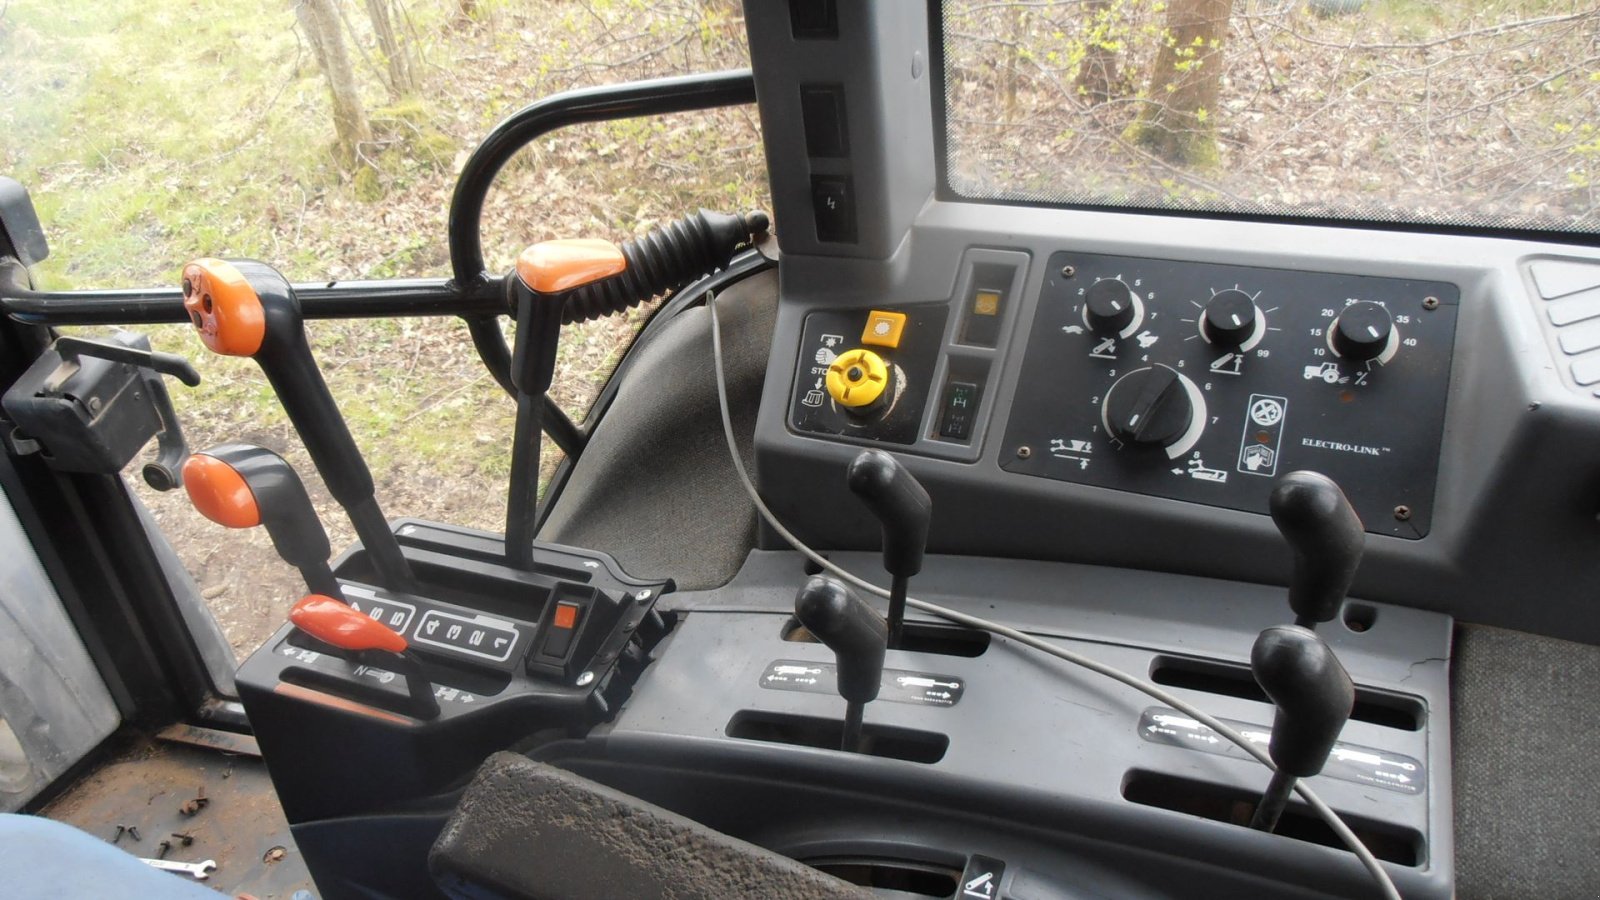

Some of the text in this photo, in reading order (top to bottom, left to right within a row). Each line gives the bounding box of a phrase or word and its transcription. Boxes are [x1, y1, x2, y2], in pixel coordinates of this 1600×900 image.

[1148, 292, 1154, 300] 6
[1321, 308, 1334, 317] 20
[1396, 315, 1410, 323] 35
[1310, 328, 1322, 336] 15
[1403, 338, 1417, 346] 40
[1257, 349, 1270, 357] 99
[1313, 348, 1325, 356] 10
[811, 366, 829, 375] STO
[1109, 369, 1116, 377] 3
[1091, 396, 1099, 404] 2
[1212, 416, 1219, 424] 7
[1301, 437, 1380, 456] ELECTRO-LINK
[1193, 451, 1201, 459] 8
[389, 612, 405, 626] 5
[426, 619, 508, 649] 4 3 2 1
